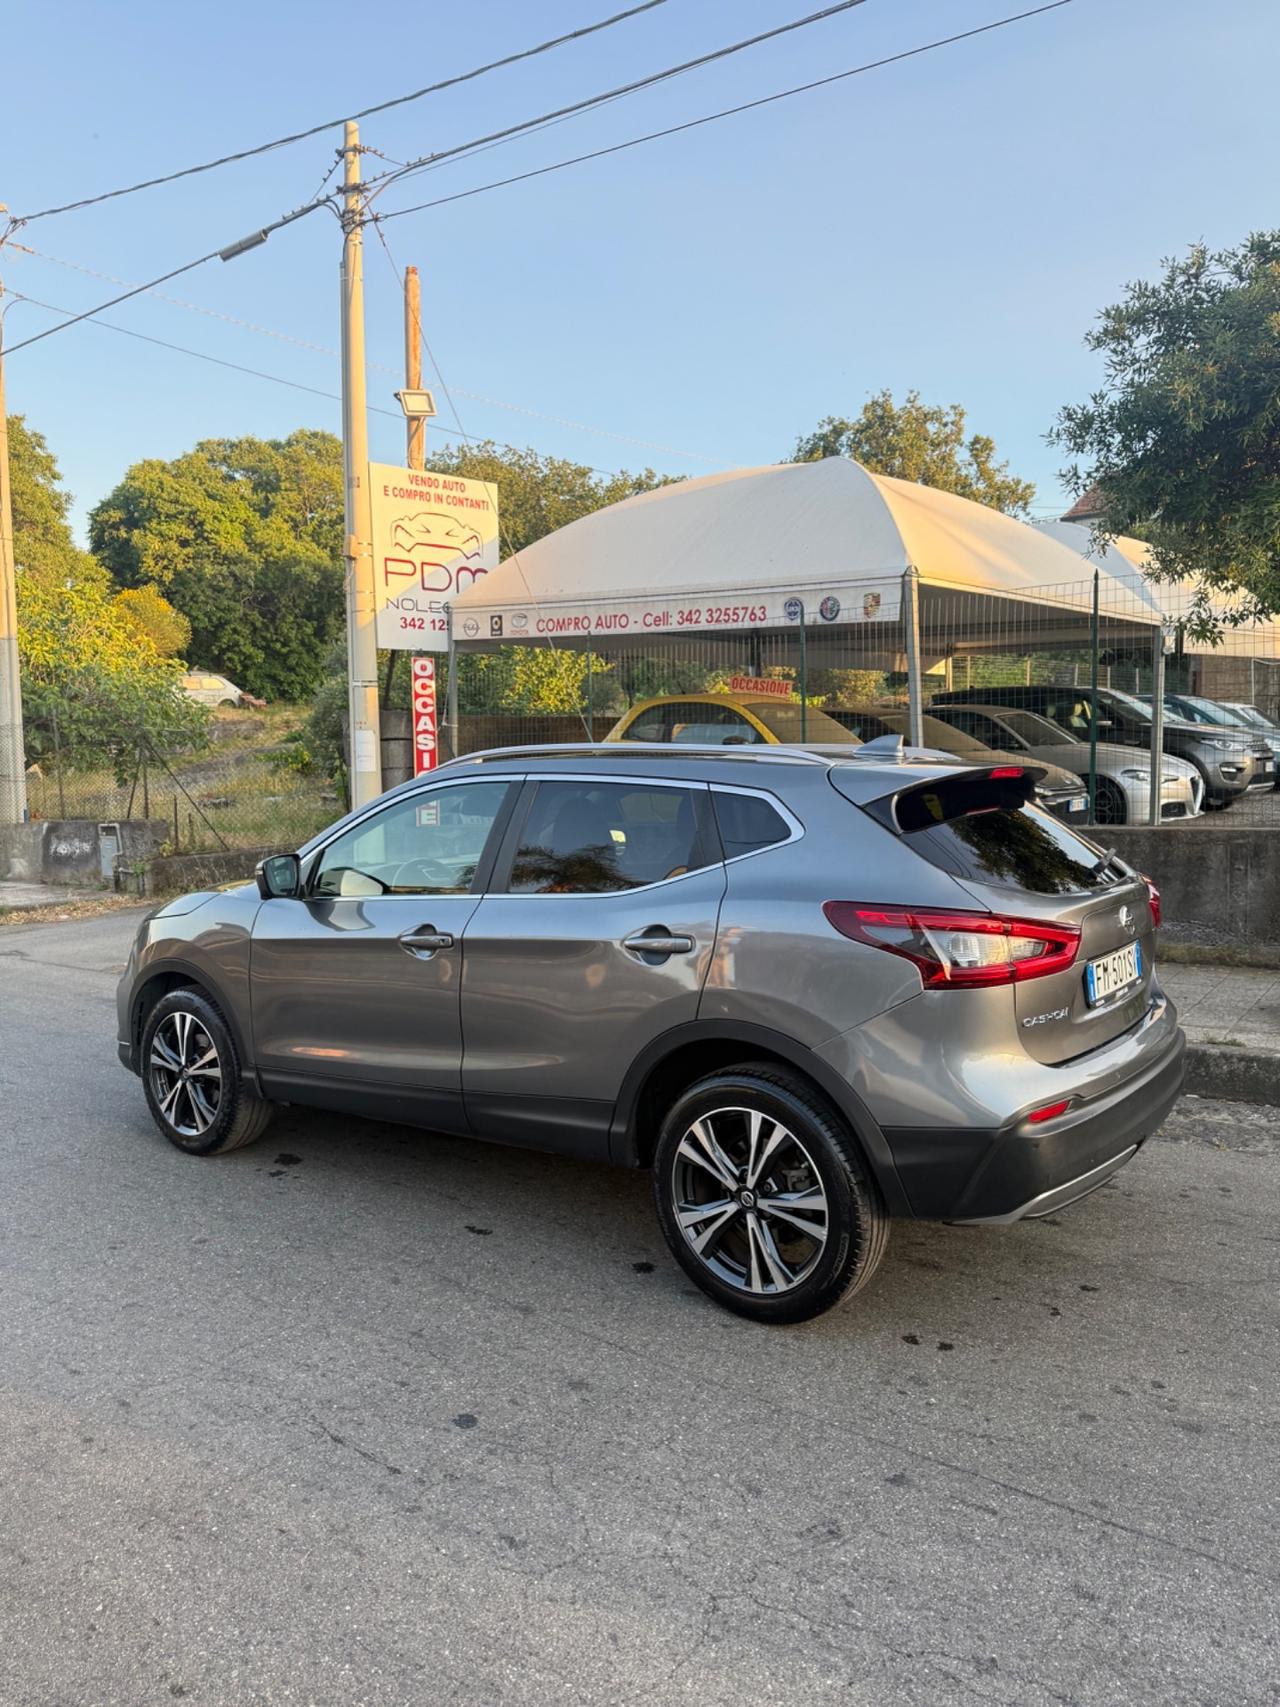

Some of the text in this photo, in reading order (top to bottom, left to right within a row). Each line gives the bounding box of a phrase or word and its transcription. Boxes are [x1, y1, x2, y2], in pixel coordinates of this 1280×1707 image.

[408, 473, 466, 493] VENDO AUTO
[383, 485, 490, 511] E COMPRO IN CONTANTI
[400, 616, 425, 630] 342
[430, 618, 449, 631] 12
[536, 615, 592, 634] COMPRO
[594, 613, 630, 630] AUTO
[642, 610, 673, 628] Cell:
[676, 608, 702, 626] 342
[705, 605, 767, 625] 3255763
[731, 677, 791, 695] OCCASIONE
